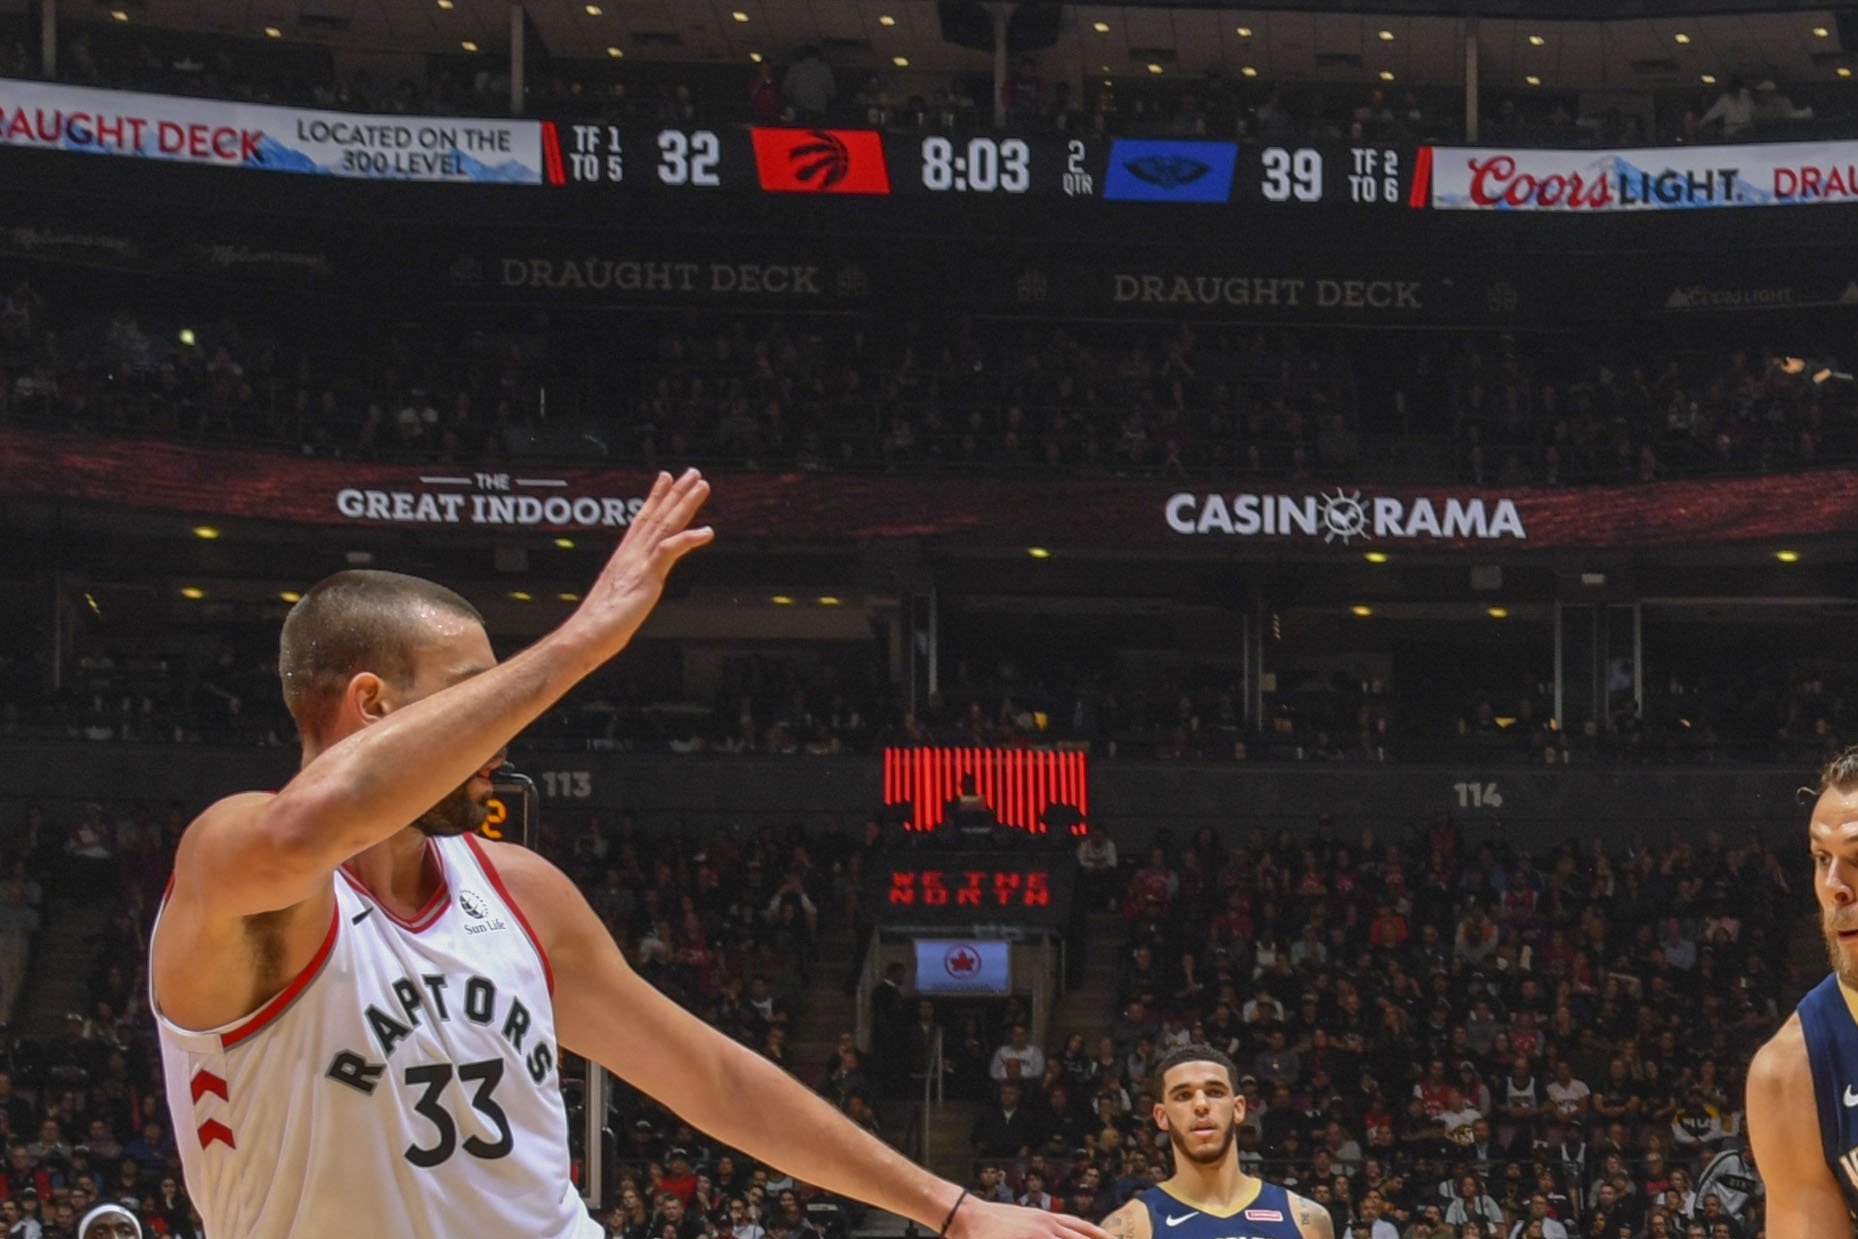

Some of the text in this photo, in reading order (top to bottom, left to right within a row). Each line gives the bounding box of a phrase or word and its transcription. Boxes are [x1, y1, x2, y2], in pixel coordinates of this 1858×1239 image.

[157, 121, 267, 162] DECK
[296, 119, 512, 153] LOCATED ON THE
[573, 126, 621, 153] TF 1
[341, 150, 467, 177] 300 LEVEL
[573, 155, 622, 181] TO 5
[658, 130, 720, 185] 32
[920, 137, 1031, 192] 8:03
[1067, 140, 1085, 173] 2
[1352, 149, 1398, 174] TF 2
[1062, 172, 1093, 195] QTR
[1261, 147, 1322, 201] 39
[1349, 175, 1398, 202] TO 6
[1468, 155, 1614, 208] Coors
[502, 258, 819, 294] DRAUGHT DECK
[1114, 274, 1422, 309] DRAUGHT DECK
[473, 472, 511, 492] THE
[337, 488, 640, 526] GREAT INDOORS
[543, 771, 592, 797] 113
[1454, 783, 1503, 807] 114
[482, 799, 507, 839] 2
[465, 918, 506, 935] Sun Life
[324, 973, 554, 1096] RAPTORS
[403, 1057, 515, 1168] 33
